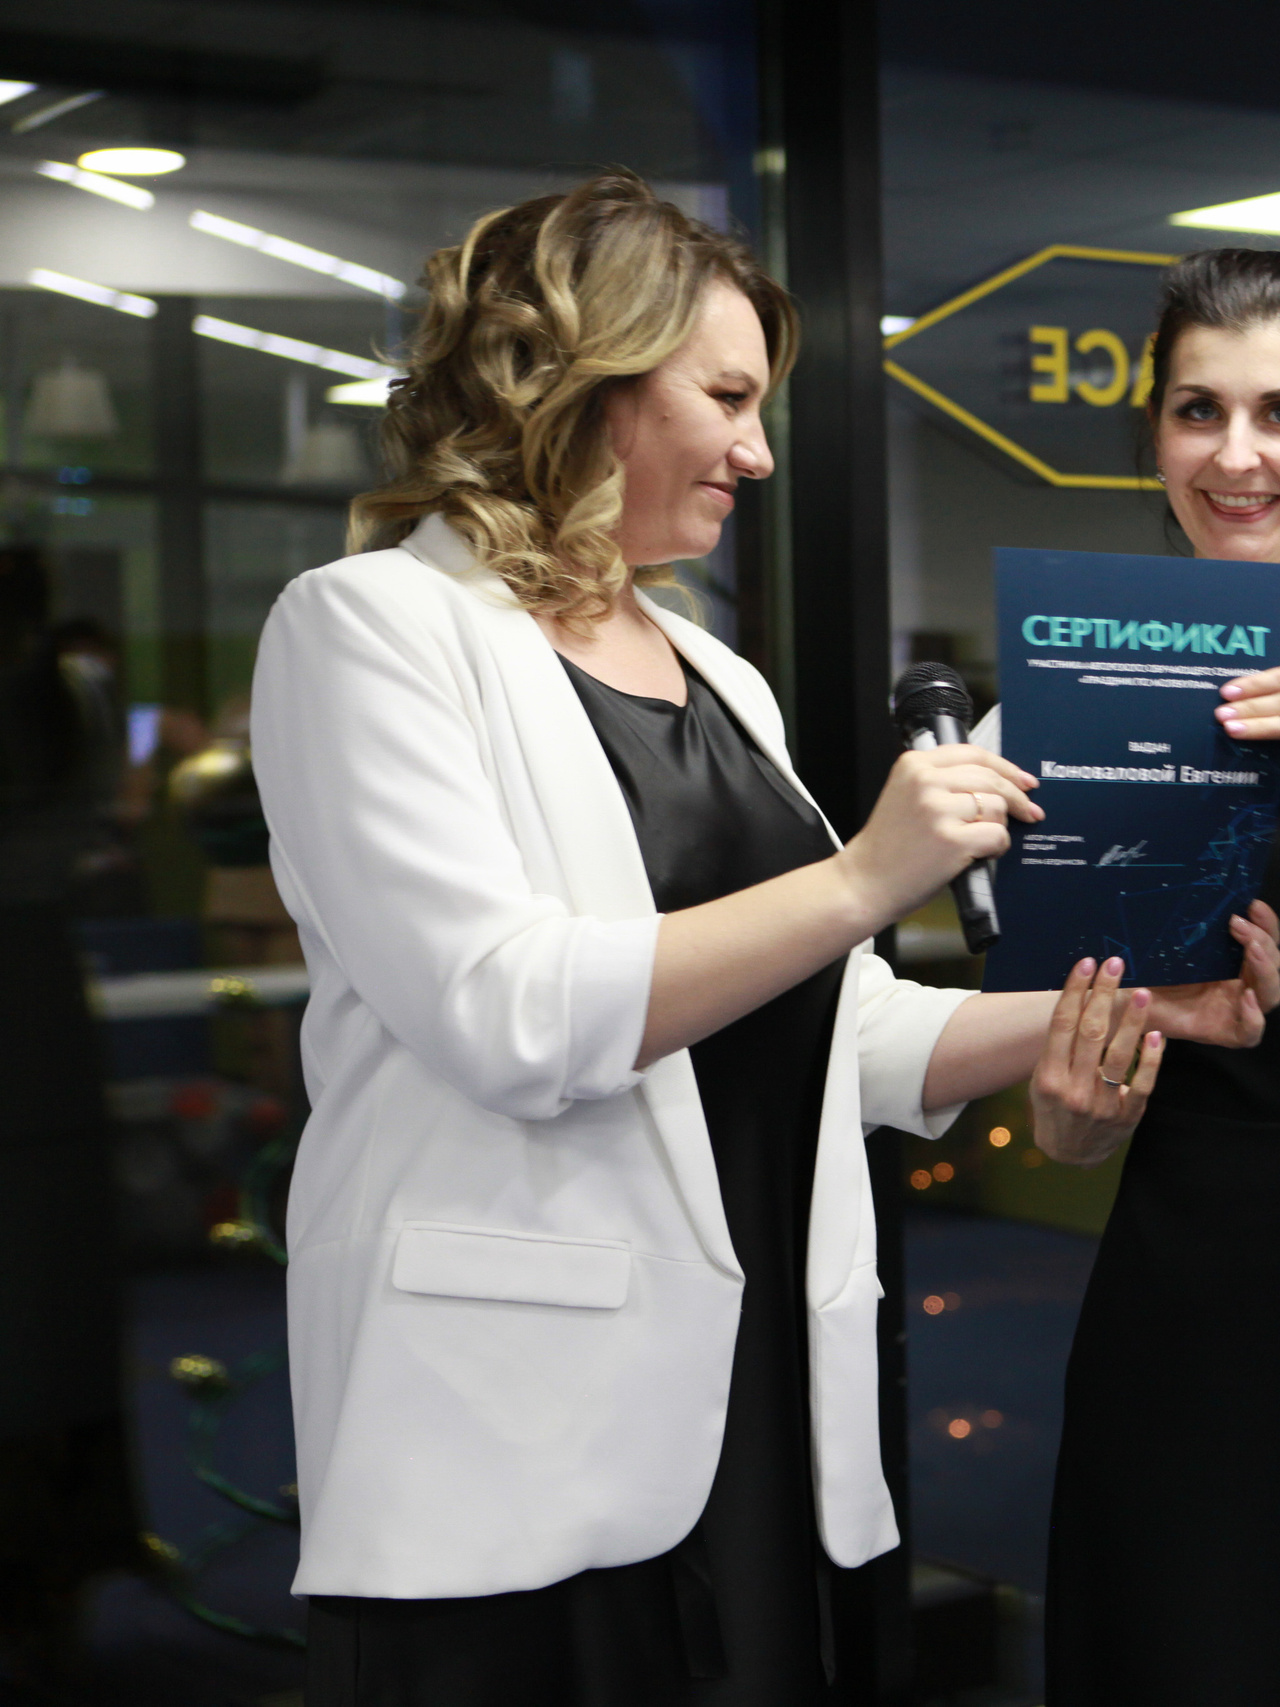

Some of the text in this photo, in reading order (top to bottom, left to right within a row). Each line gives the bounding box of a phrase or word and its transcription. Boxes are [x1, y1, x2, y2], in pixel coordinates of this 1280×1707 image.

[1021, 614, 1271, 657] СЕРТИФИКАТ
[1041, 760, 1260, 785] Коноваловой Евгении
